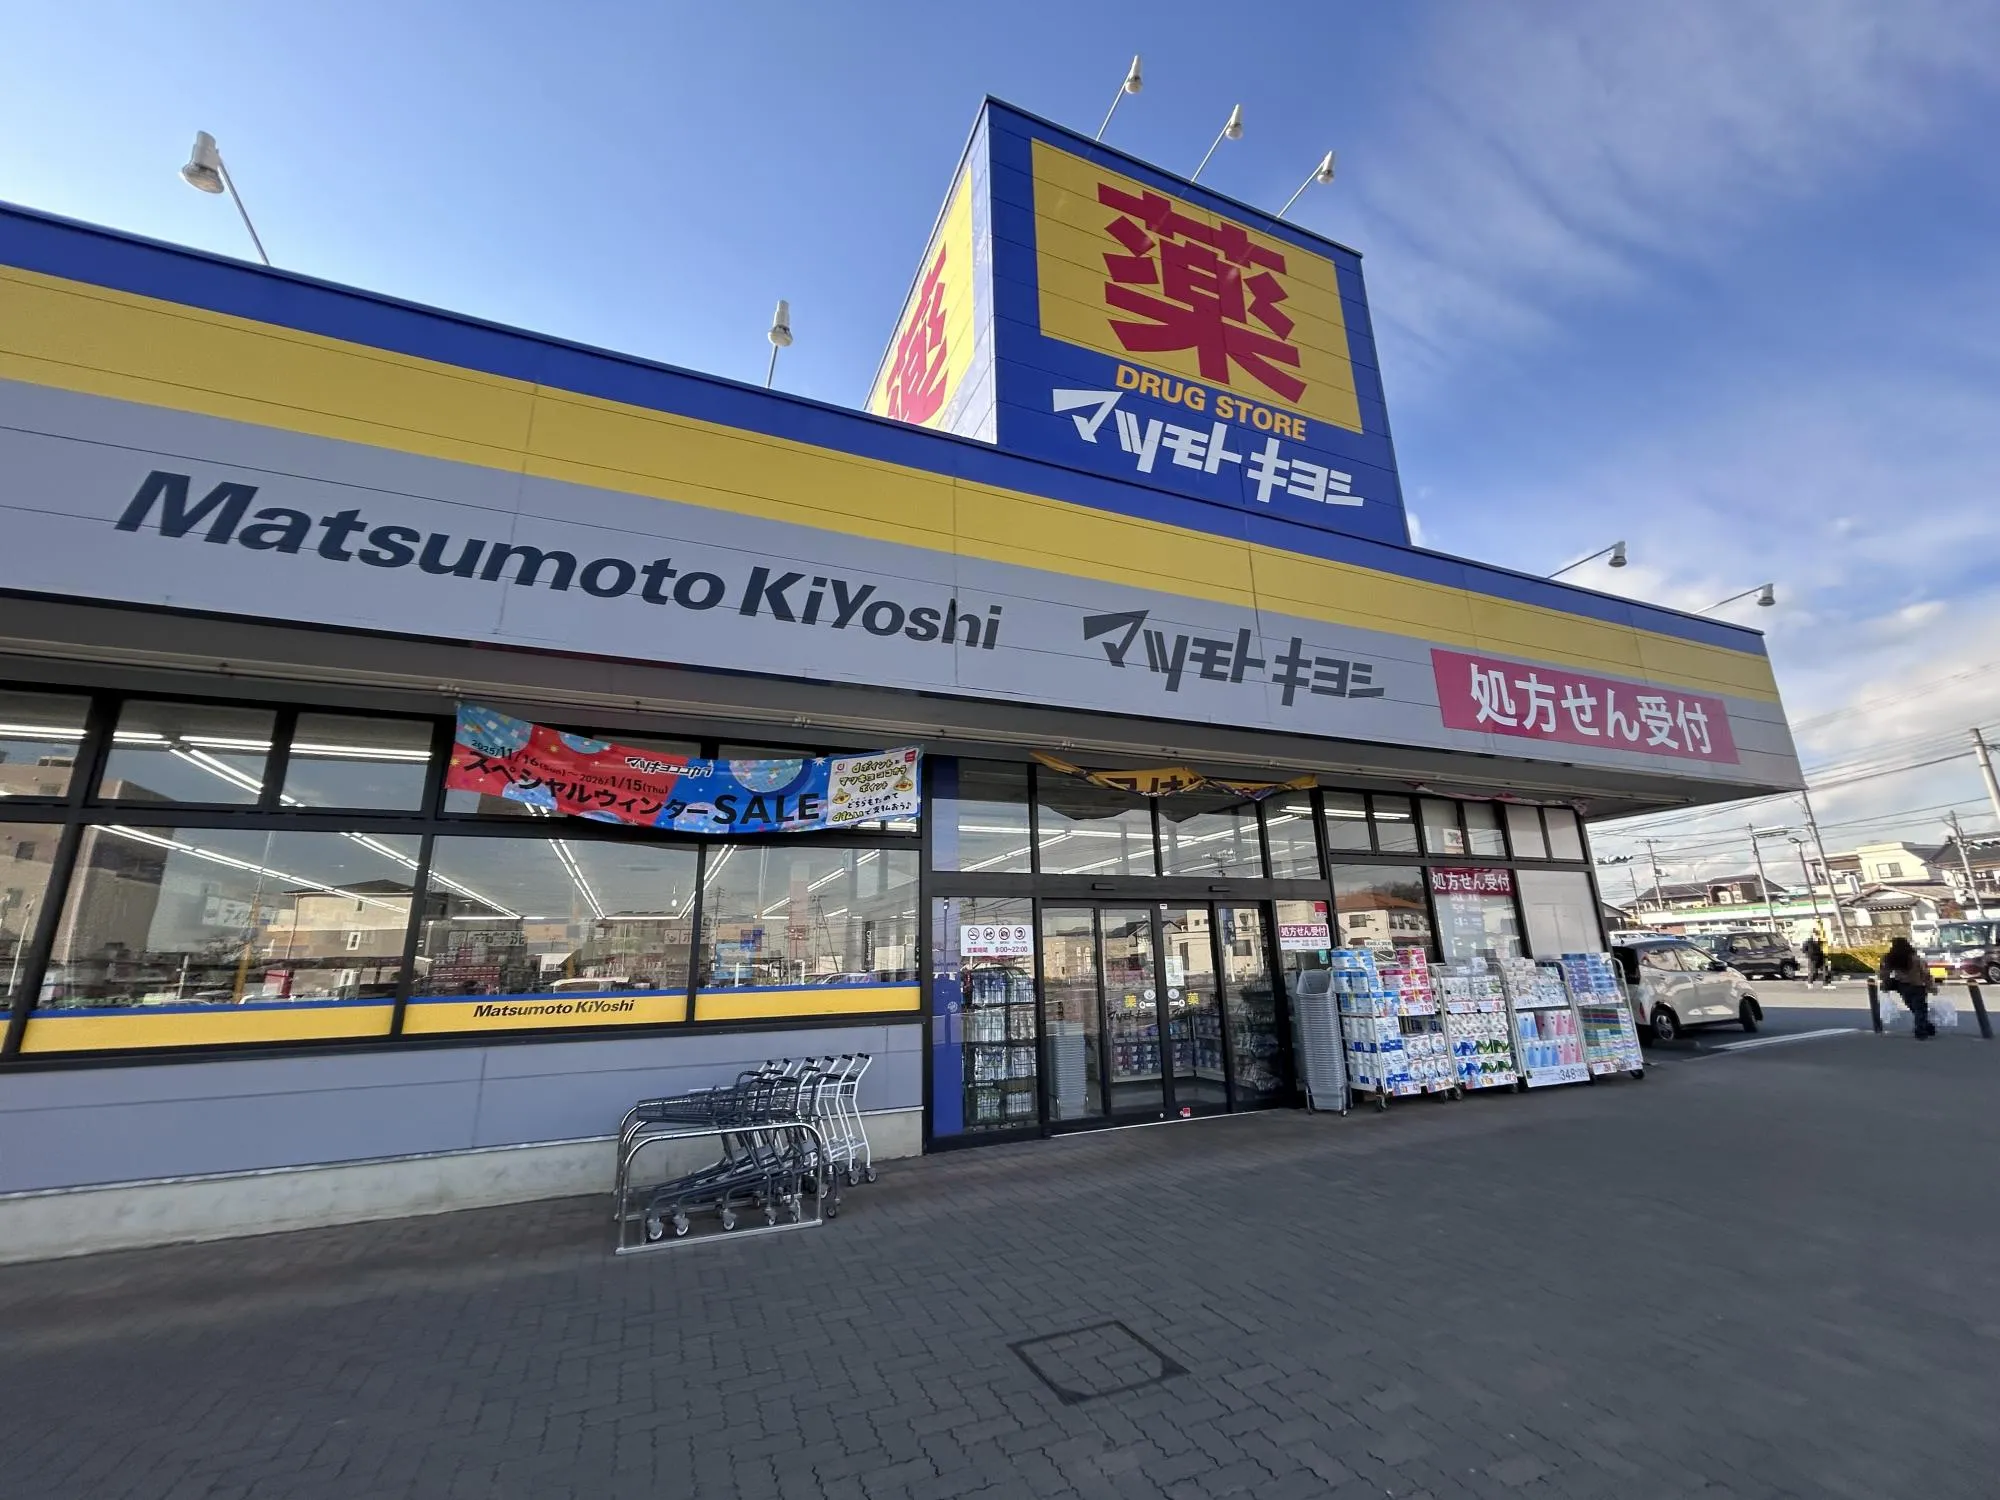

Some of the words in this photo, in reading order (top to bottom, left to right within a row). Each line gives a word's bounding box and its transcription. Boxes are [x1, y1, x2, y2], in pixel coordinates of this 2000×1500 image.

[1097, 182, 1307, 404] 薬
[1053, 388, 1364, 506] マツモトキヨシ
[1115, 364, 1205, 411] DRUG
[1216, 396, 1306, 441] STORE
[114, 470, 725, 611] Matsumoto
[739, 566, 1003, 650] KiYoshi
[1083, 609, 1385, 706] マツモトキヨシ
[1470, 662, 1712, 754] 処方せん受付
[1432, 872, 1510, 891] 処方せん受付
[1281, 926, 1326, 937] 処方せん受付
[473, 1004, 573, 1017] Matsumoto
[575, 1000, 634, 1013] KiYoshi
